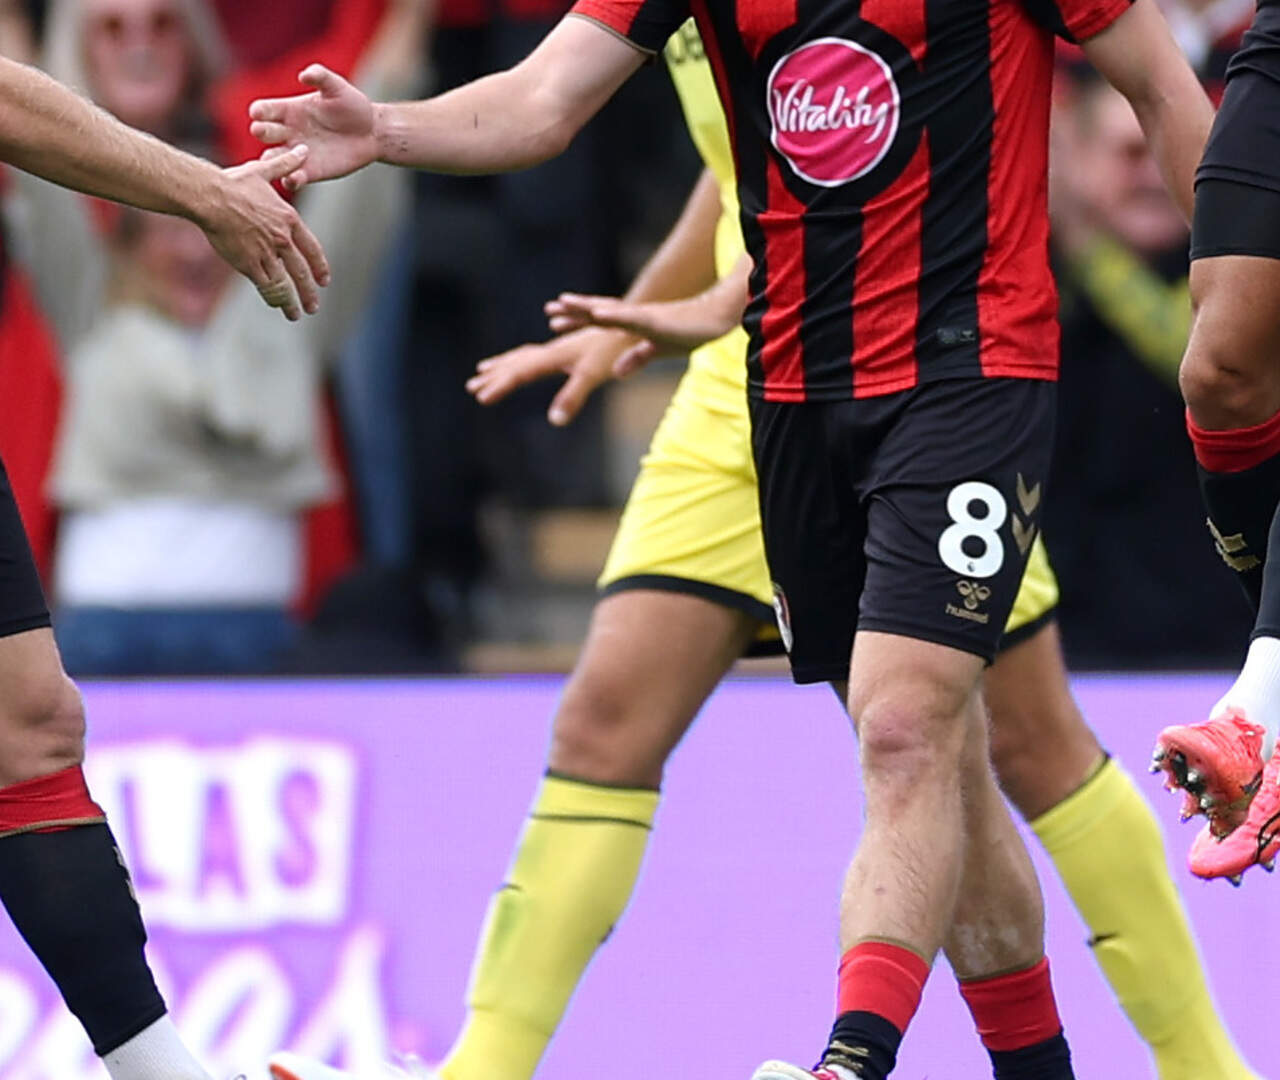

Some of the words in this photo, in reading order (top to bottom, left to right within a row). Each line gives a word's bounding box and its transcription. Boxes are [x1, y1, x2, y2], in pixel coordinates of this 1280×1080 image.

[773, 79, 889, 144] Vitality
[938, 481, 1008, 578] 8
[117, 770, 323, 900] LAS
